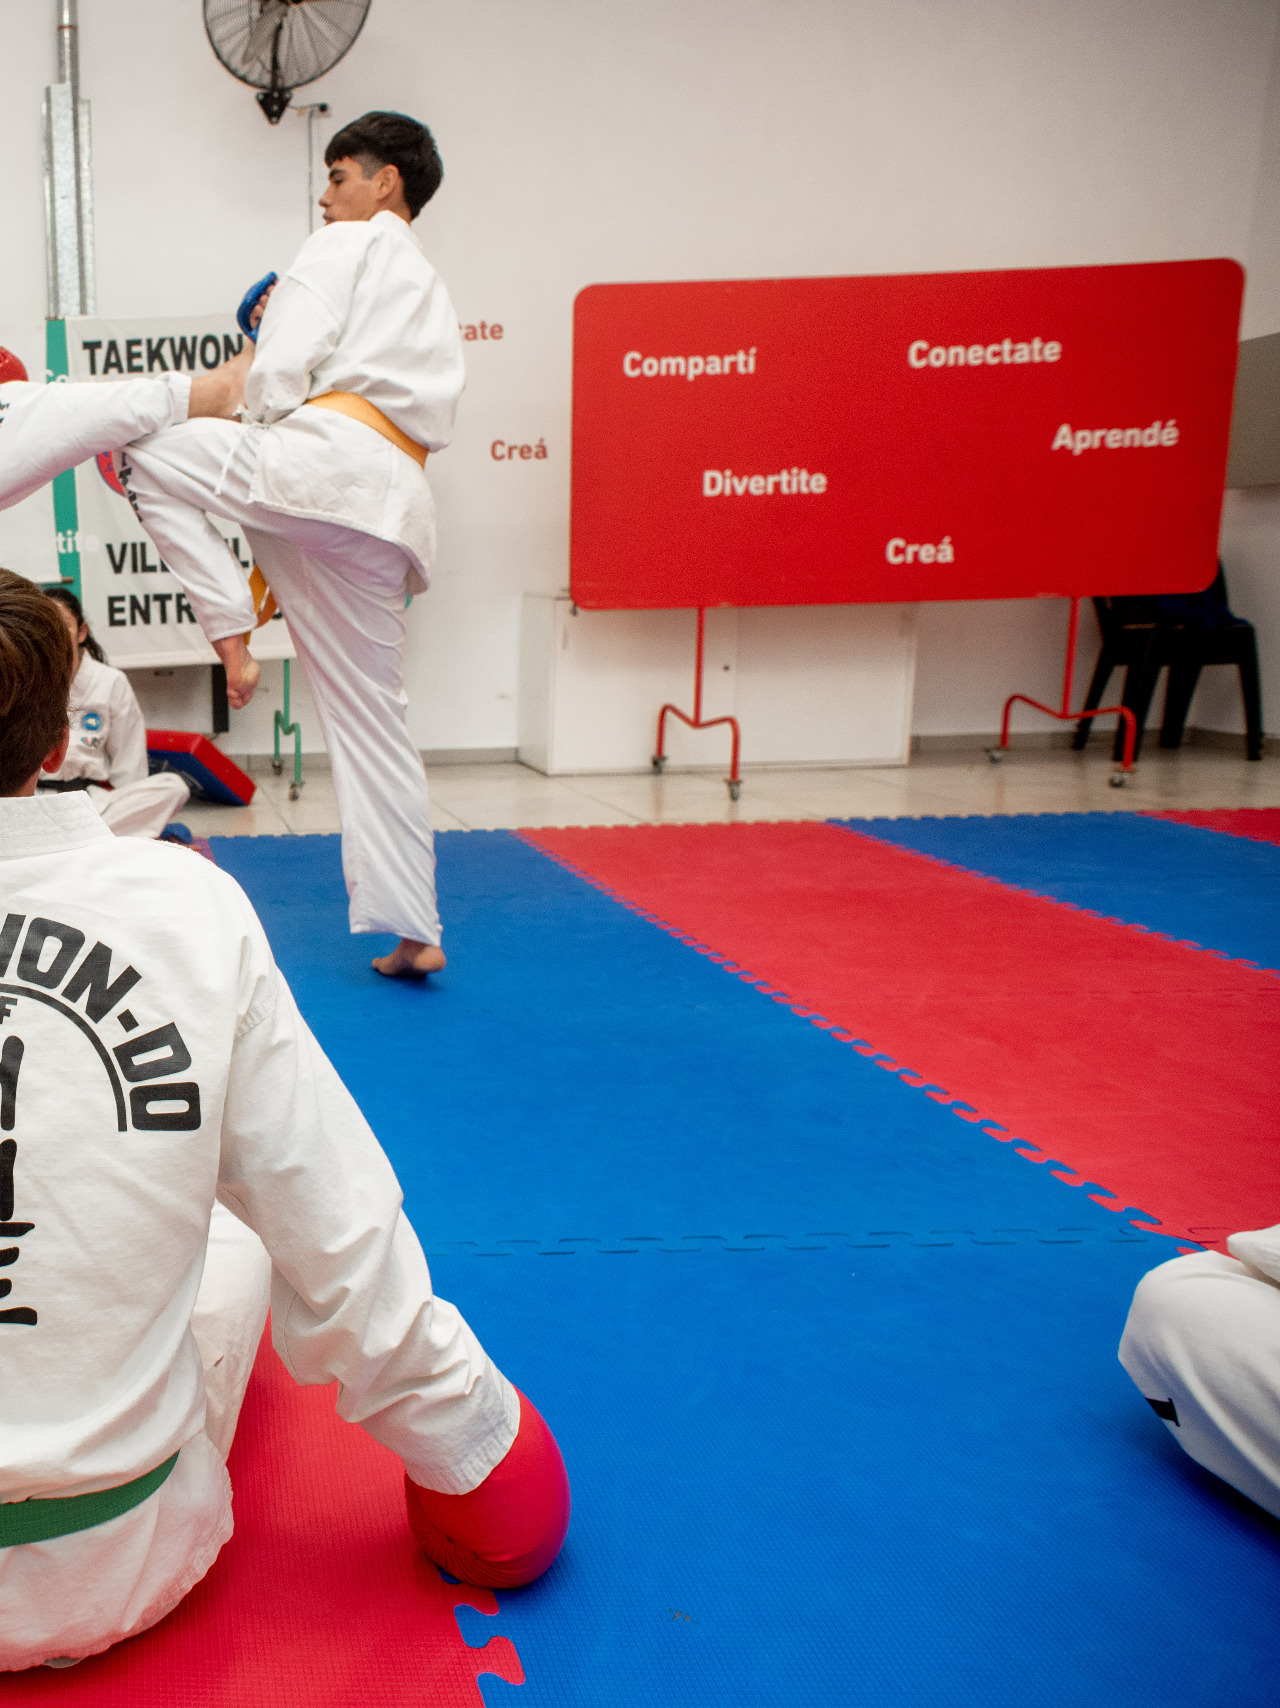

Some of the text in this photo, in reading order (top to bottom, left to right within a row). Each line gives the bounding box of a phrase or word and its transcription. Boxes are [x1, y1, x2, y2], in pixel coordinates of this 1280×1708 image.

[622, 346, 758, 382] Compartí
[908, 337, 1062, 369] Conectate
[490, 437, 548, 461] Creá
[1052, 420, 1179, 456] Aprendé
[702, 467, 828, 498] Divertite
[885, 535, 955, 565] Creá
[108, 592, 197, 627] ENTR
